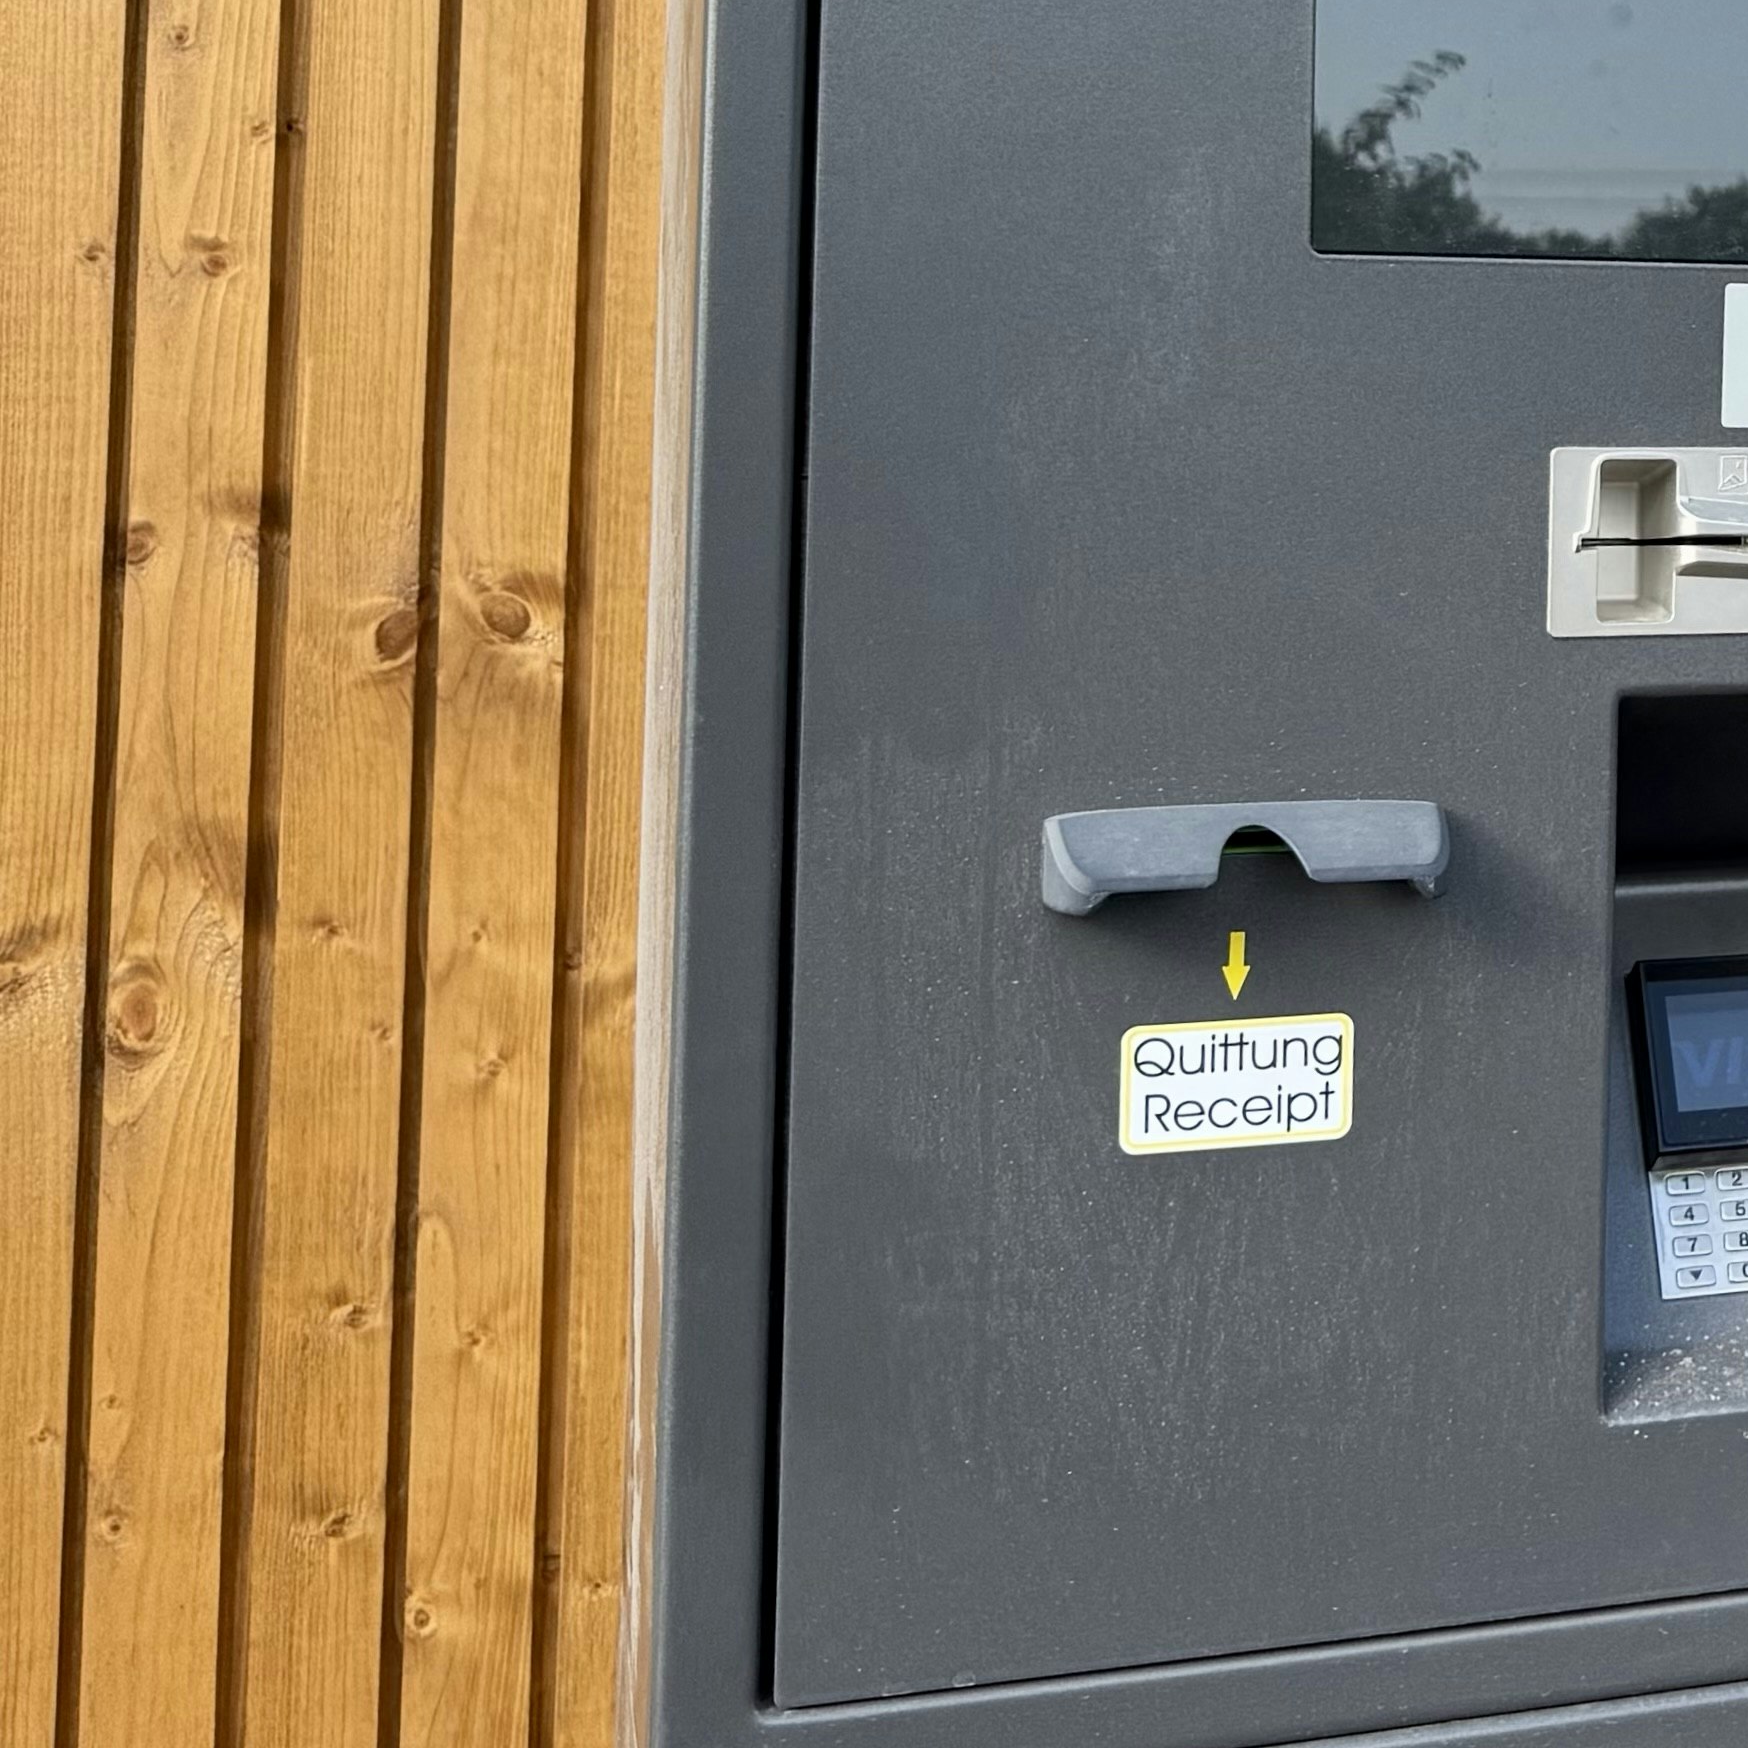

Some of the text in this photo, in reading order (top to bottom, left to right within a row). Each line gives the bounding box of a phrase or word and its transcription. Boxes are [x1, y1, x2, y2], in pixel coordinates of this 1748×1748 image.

[1134, 1032, 1342, 1077] Quittung
[1144, 1081, 1335, 1133] Receipt
[1680, 1176, 1689, 1190] 1
[1732, 1171, 1742, 1186] 2
[1684, 1206, 1694, 1221] 4
[1735, 1201, 1746, 1216] 5
[1687, 1237, 1697, 1252] 7
